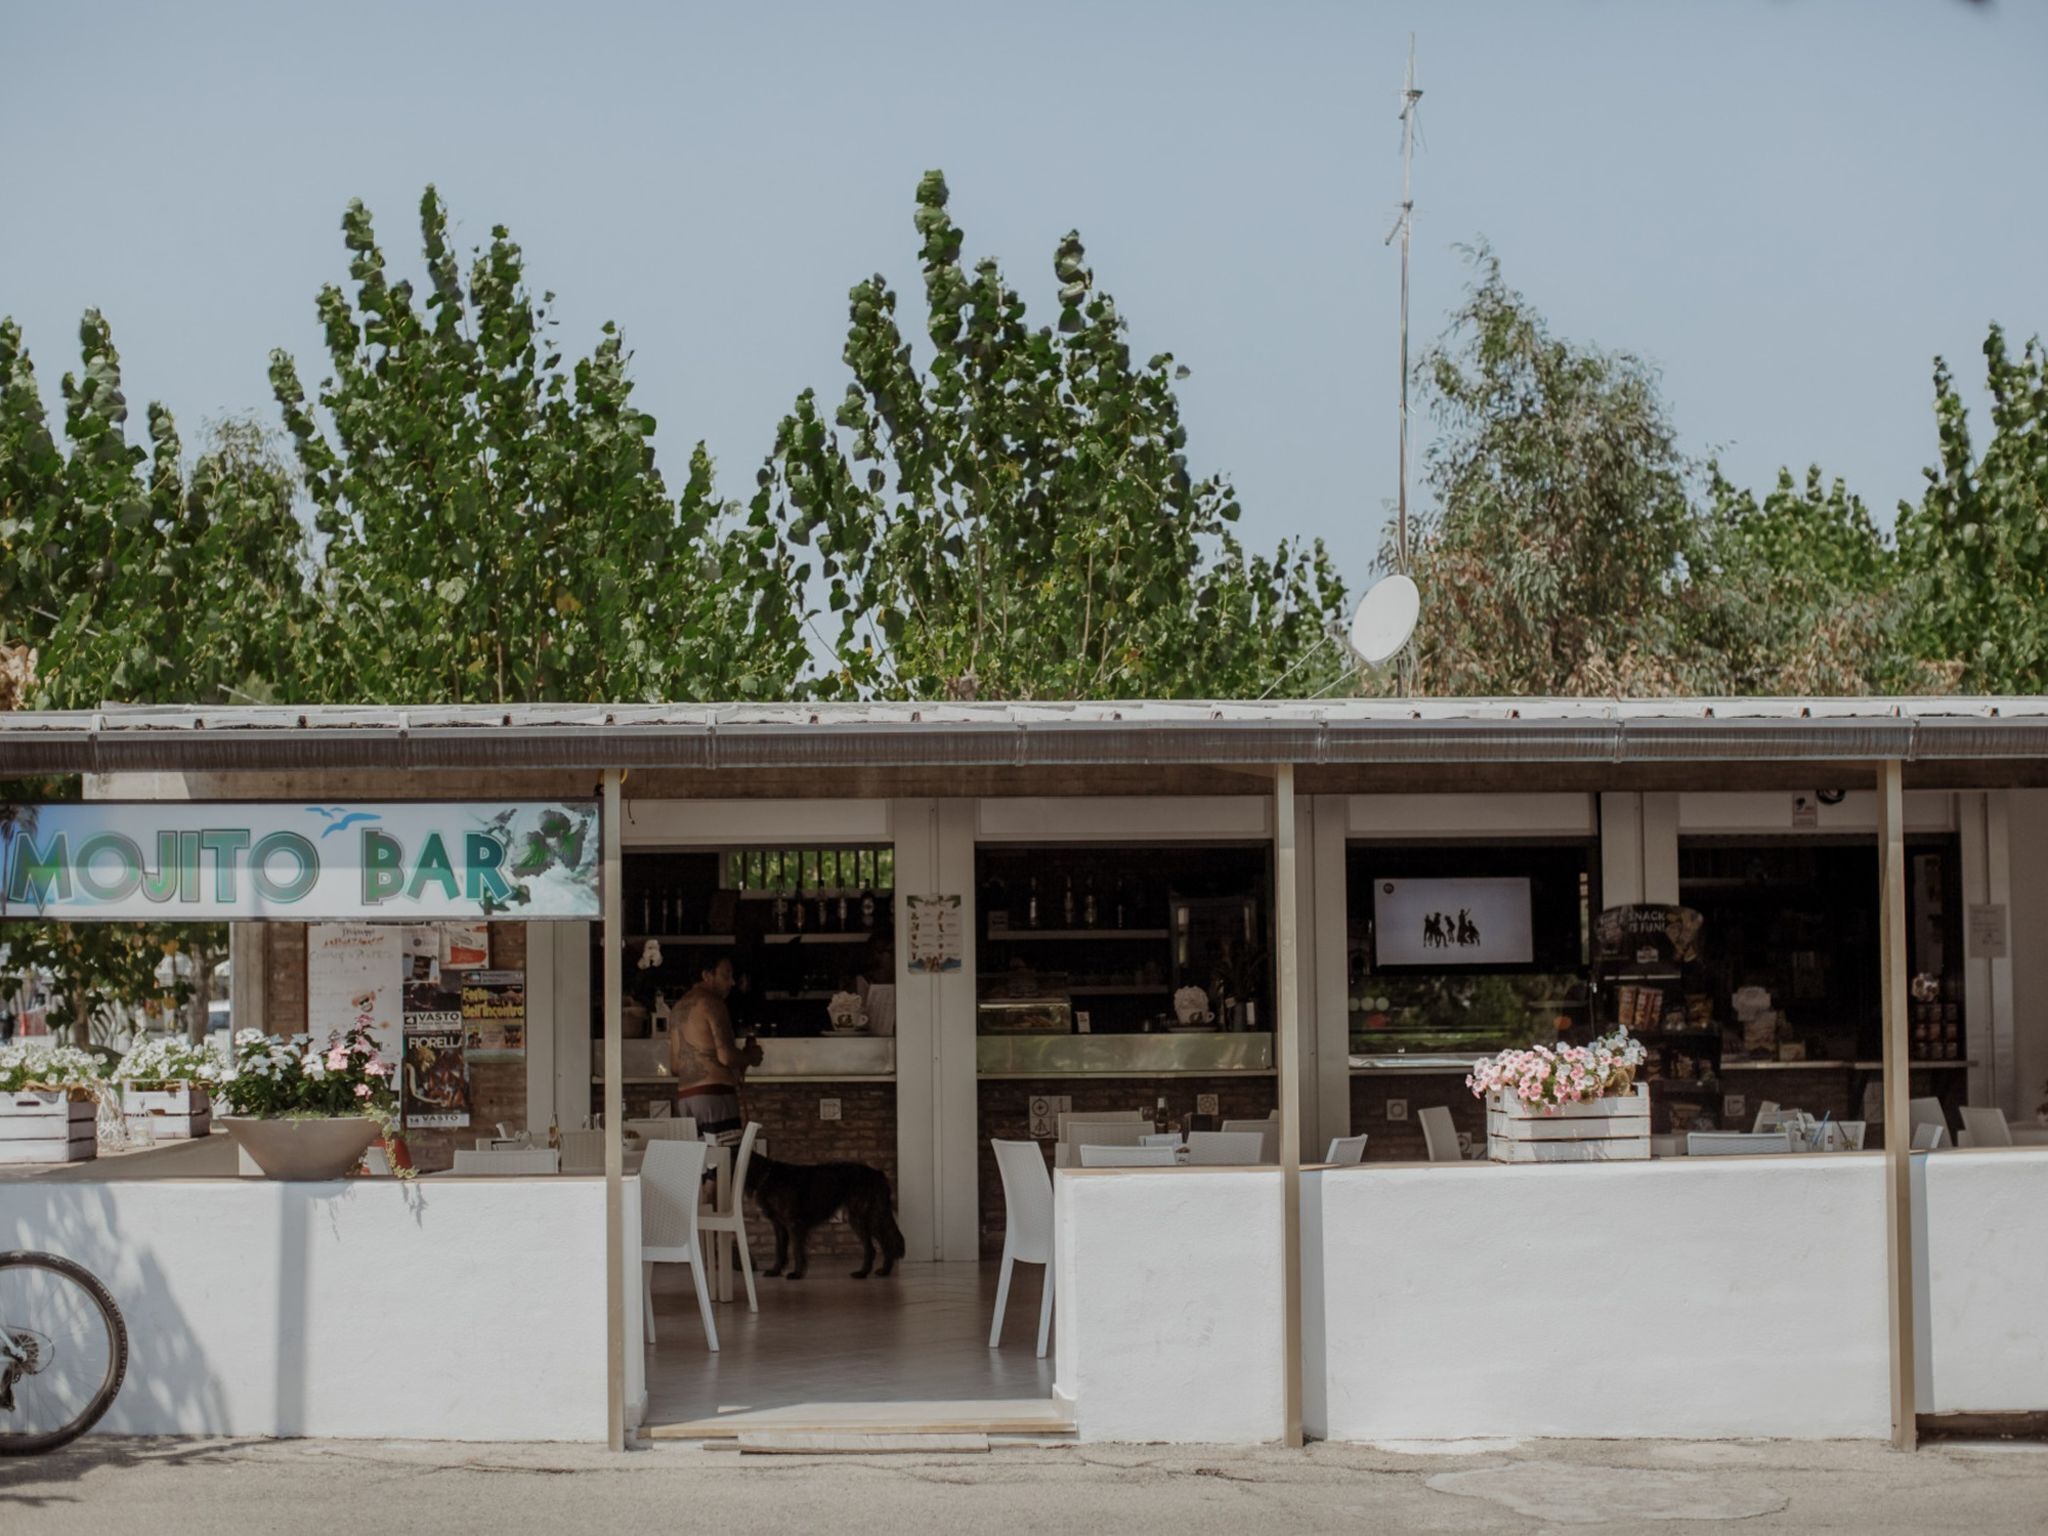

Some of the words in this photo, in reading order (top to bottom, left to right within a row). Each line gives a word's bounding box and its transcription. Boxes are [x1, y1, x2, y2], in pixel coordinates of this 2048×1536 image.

[8, 829, 320, 914] MOJITO
[361, 828, 513, 905] BAR
[1628, 911, 1666, 922] SNACK
[418, 1013, 459, 1021] VASTO
